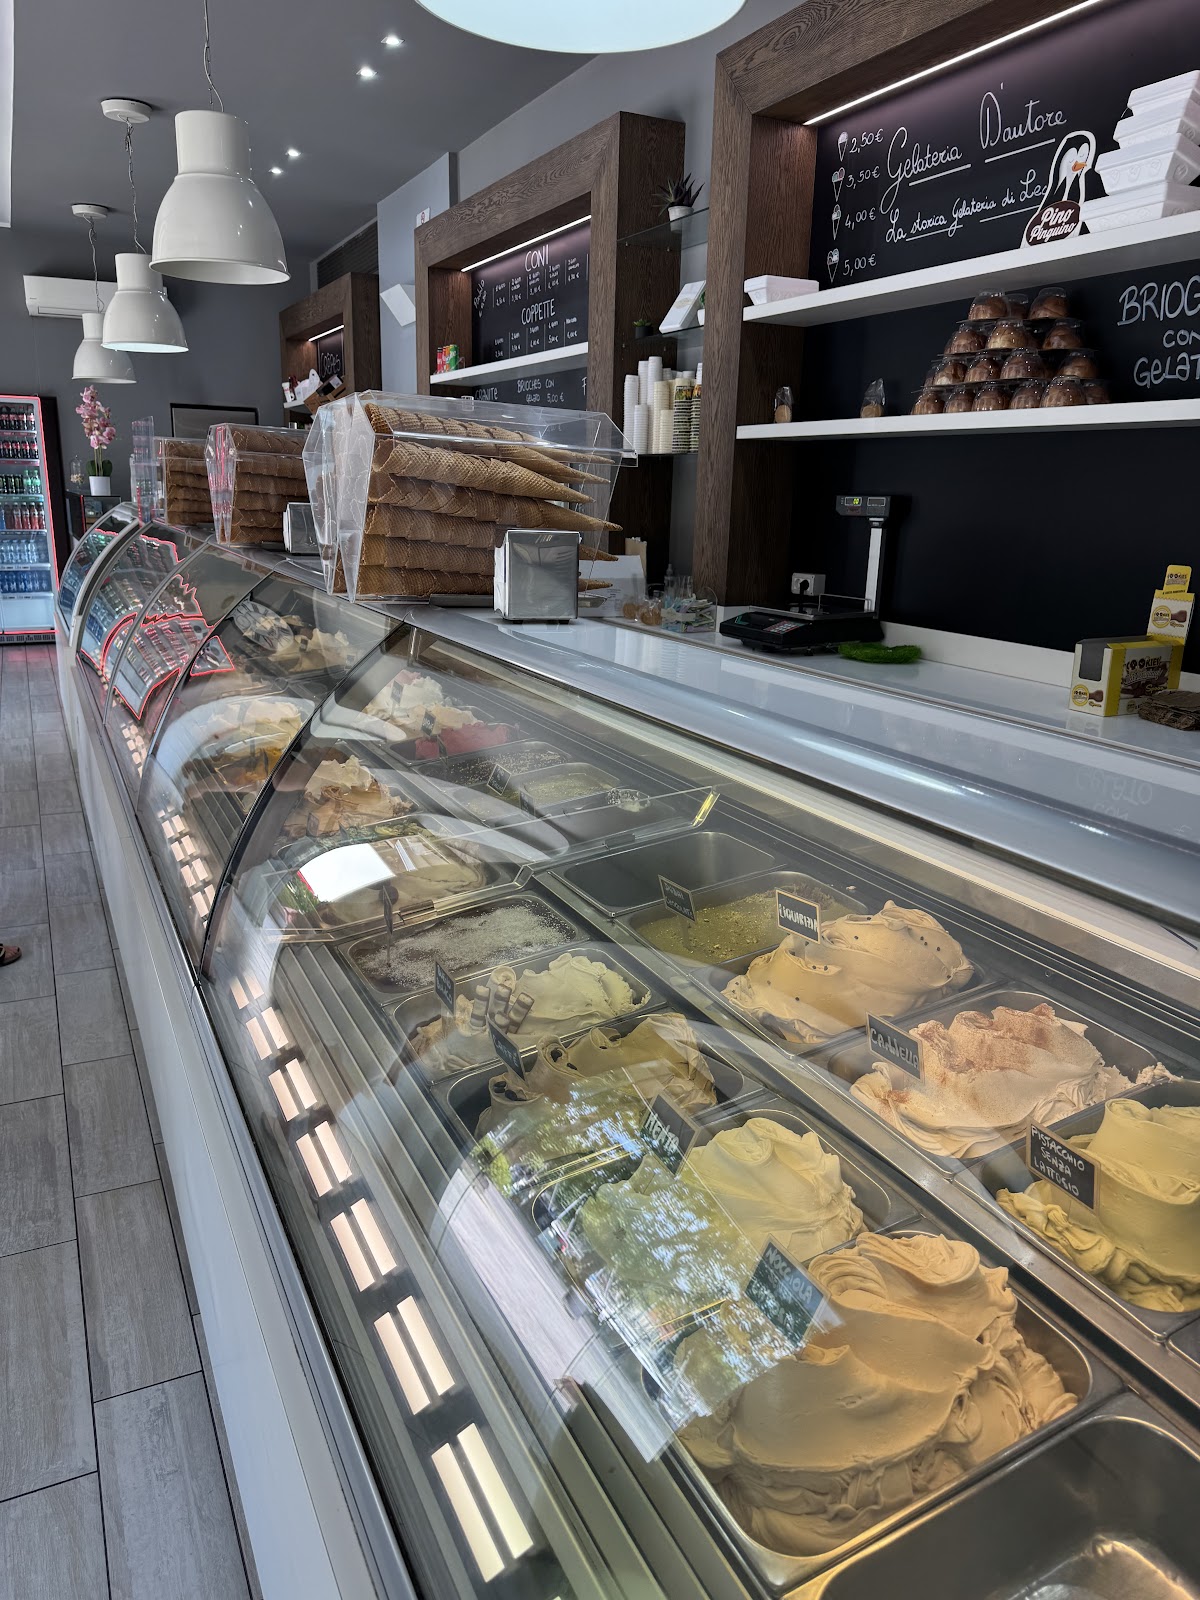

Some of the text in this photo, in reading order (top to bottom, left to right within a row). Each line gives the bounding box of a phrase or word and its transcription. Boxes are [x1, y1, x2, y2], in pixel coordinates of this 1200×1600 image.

[849, 128, 884, 154] 2,50€
[846, 166, 881, 189] 3,50€
[880, 127, 962, 214] Gelateria
[845, 208, 876, 230] 4,00€
[886, 209, 907, 242] La
[910, 212, 947, 234] storica
[948, 197, 996, 237] Gelateria
[1002, 186, 1016, 206] di
[1041, 206, 1075, 227] Pino
[1028, 222, 1077, 243] Pinguino
[525, 244, 549, 272] CONI
[843, 254, 876, 276] 5,00€
[521, 298, 555, 325] COPPETTE
[545, 379, 555, 389] CON
[1031, 1125, 1085, 1171] PISTACCHIO
[1040, 1147, 1072, 1177] SENZA
[1034, 1156, 1079, 1197] LATTOSIO
[765, 1247, 813, 1304] NOCCIOLA
